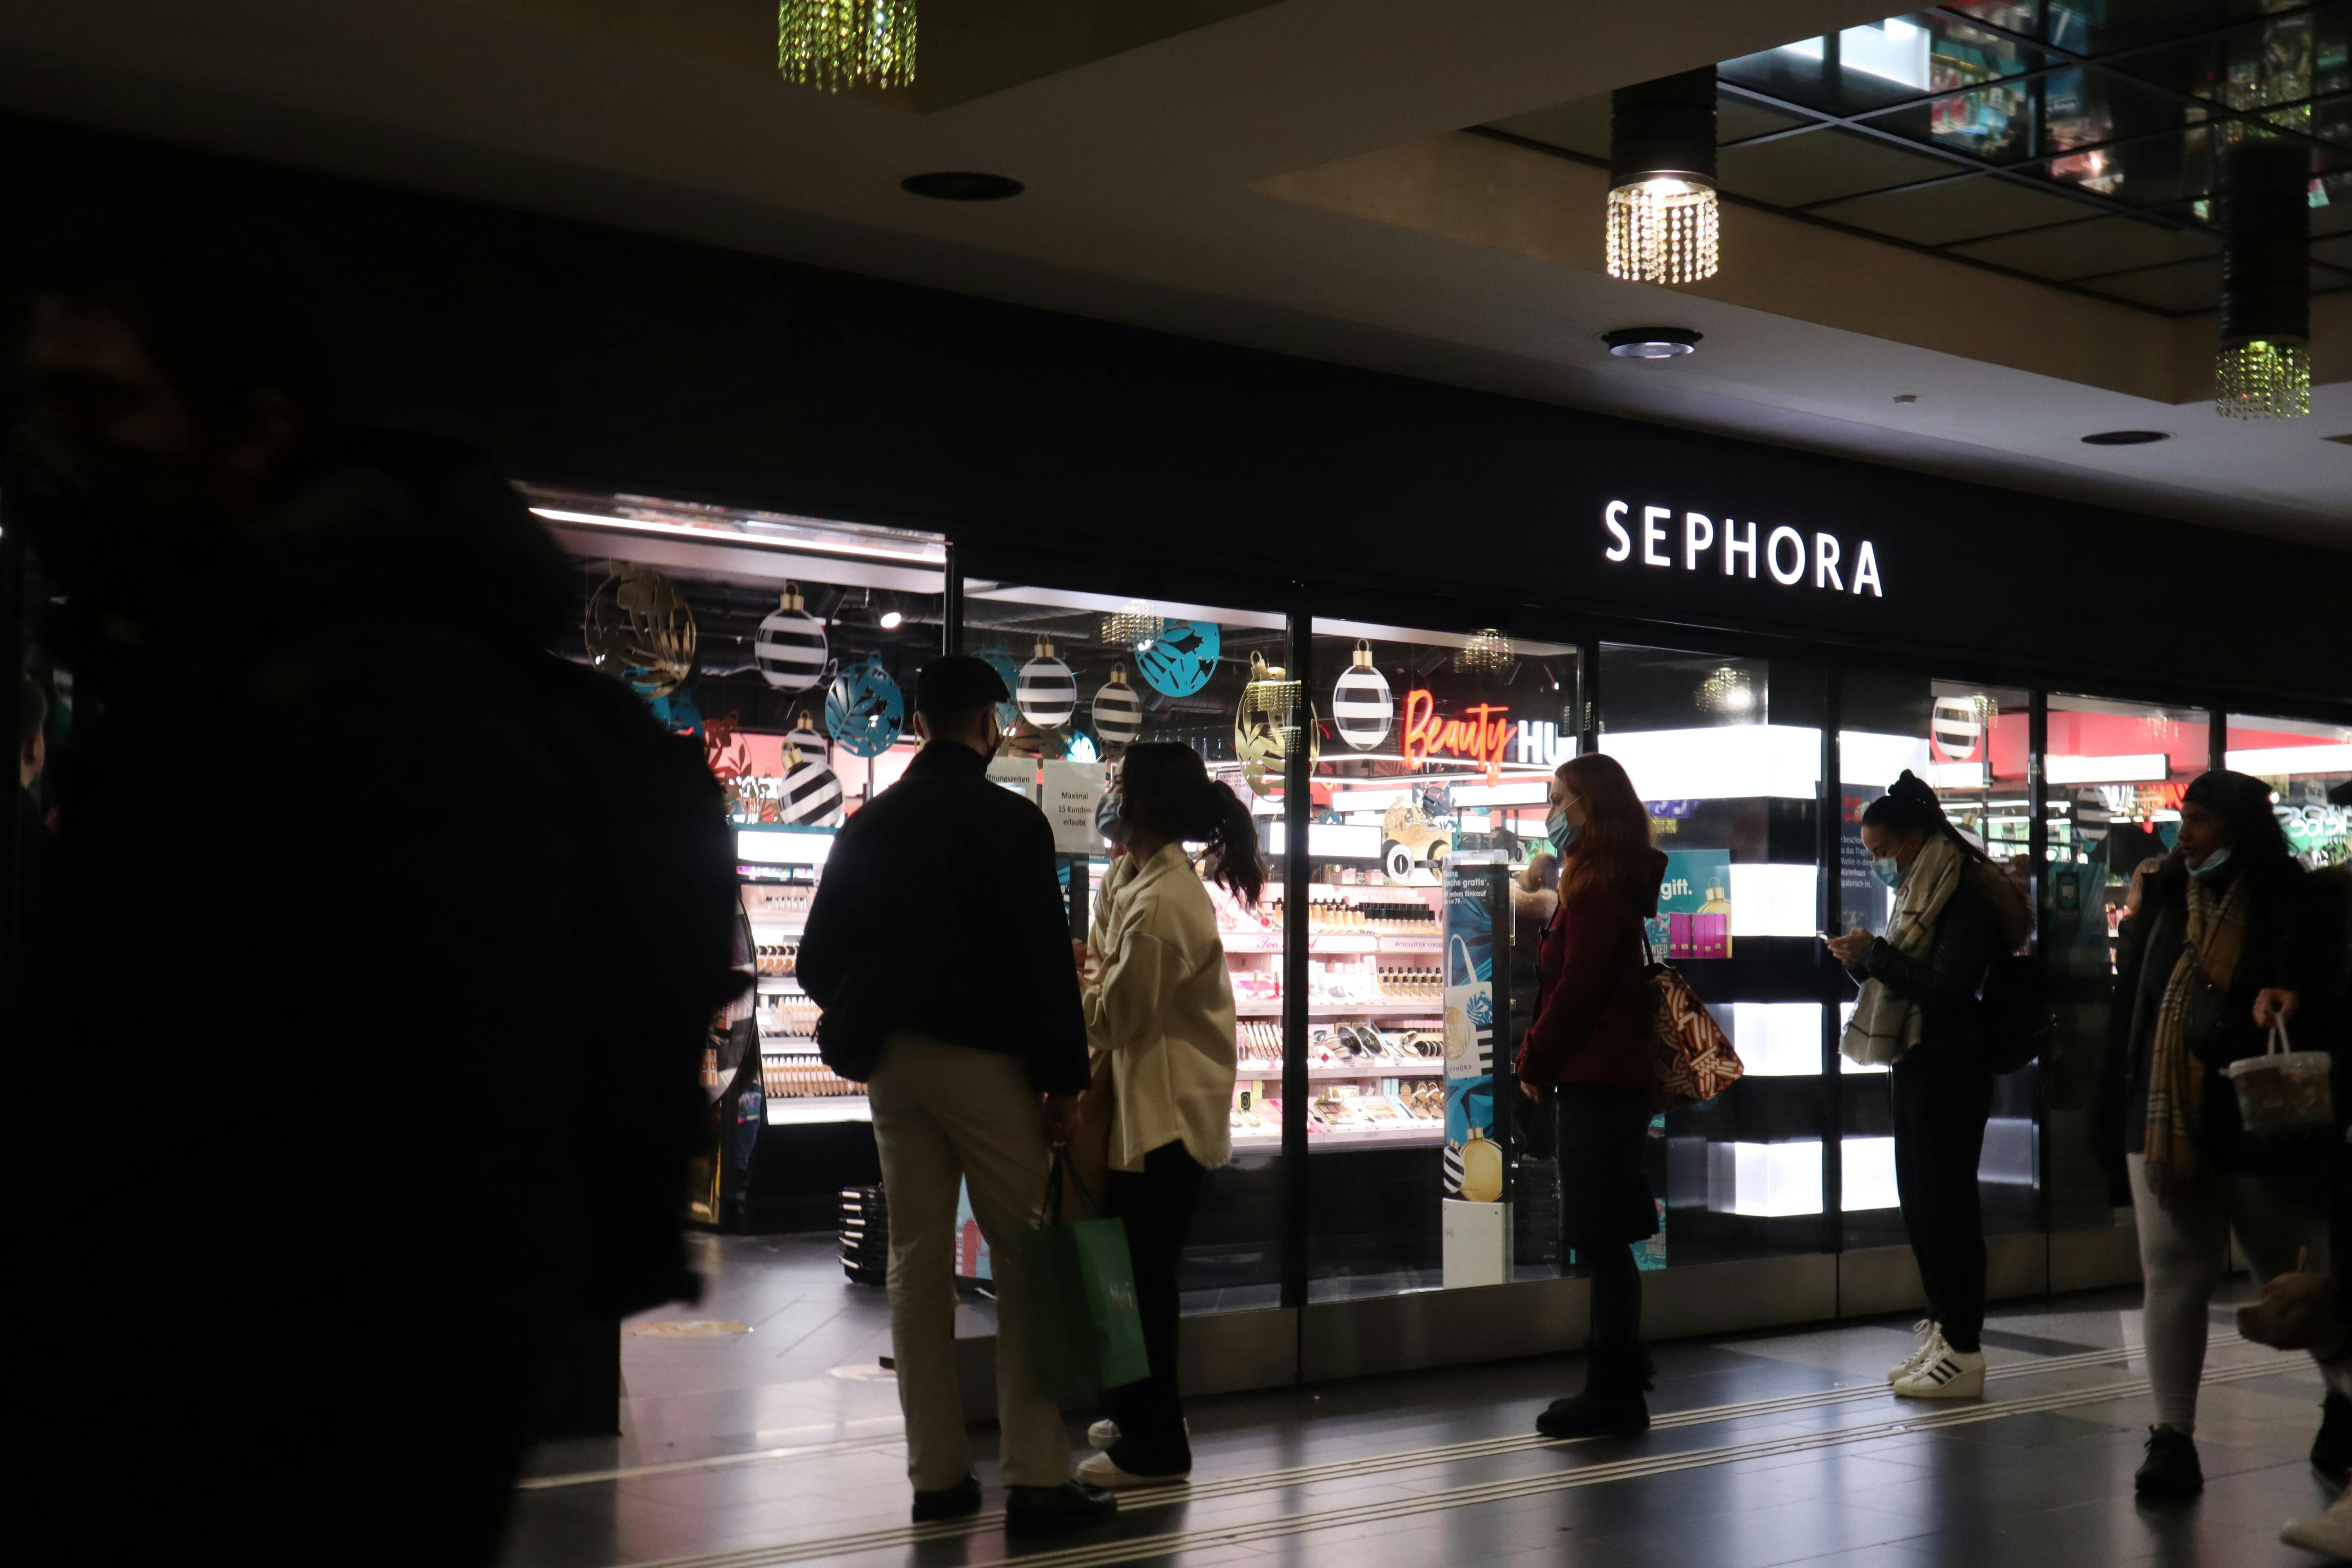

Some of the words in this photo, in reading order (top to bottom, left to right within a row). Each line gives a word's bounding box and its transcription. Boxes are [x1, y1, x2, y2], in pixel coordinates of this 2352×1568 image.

[1604, 500, 1883, 597] SEPHORA
[1403, 689, 1517, 787] Beauty
[1517, 720, 1569, 766] HU
[986, 774, 1029, 783] ffnungszeiten
[1061, 791, 1088, 800] Maximal
[1067, 806, 1091, 814] Kunden
[1063, 818, 1086, 827] erlaubt
[1843, 835, 1863, 844] beachte
[1392, 848, 1409, 857] EXKLUSIV
[1846, 846, 1854, 855] das
[1661, 879, 1692, 900] gift.
[1257, 936, 1278, 949] Too
[1448, 1064, 1472, 1073] SEPHORA
